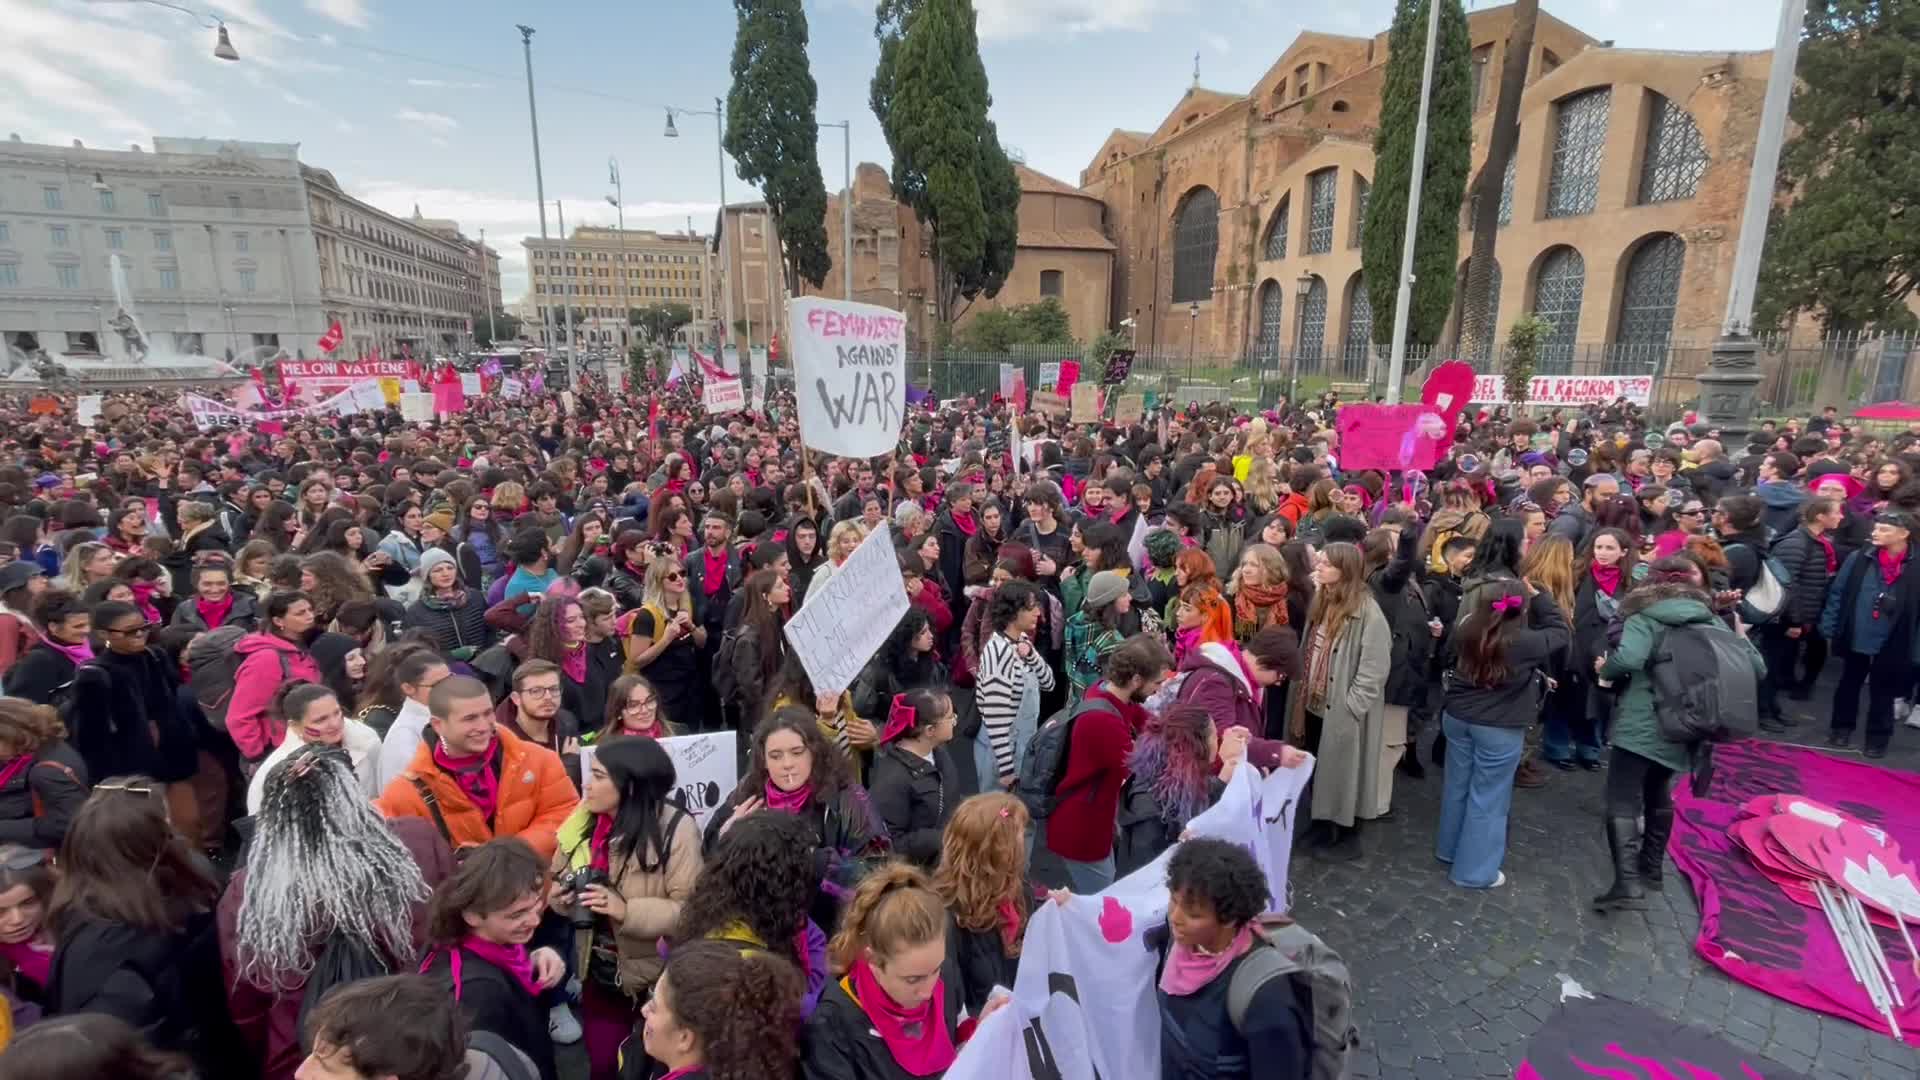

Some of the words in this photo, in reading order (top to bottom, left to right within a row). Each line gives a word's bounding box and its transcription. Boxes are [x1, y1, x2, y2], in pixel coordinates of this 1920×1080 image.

[836, 343, 898, 368] AGAINST
[281, 363, 337, 375] MELONI
[816, 371, 901, 432] WAR
